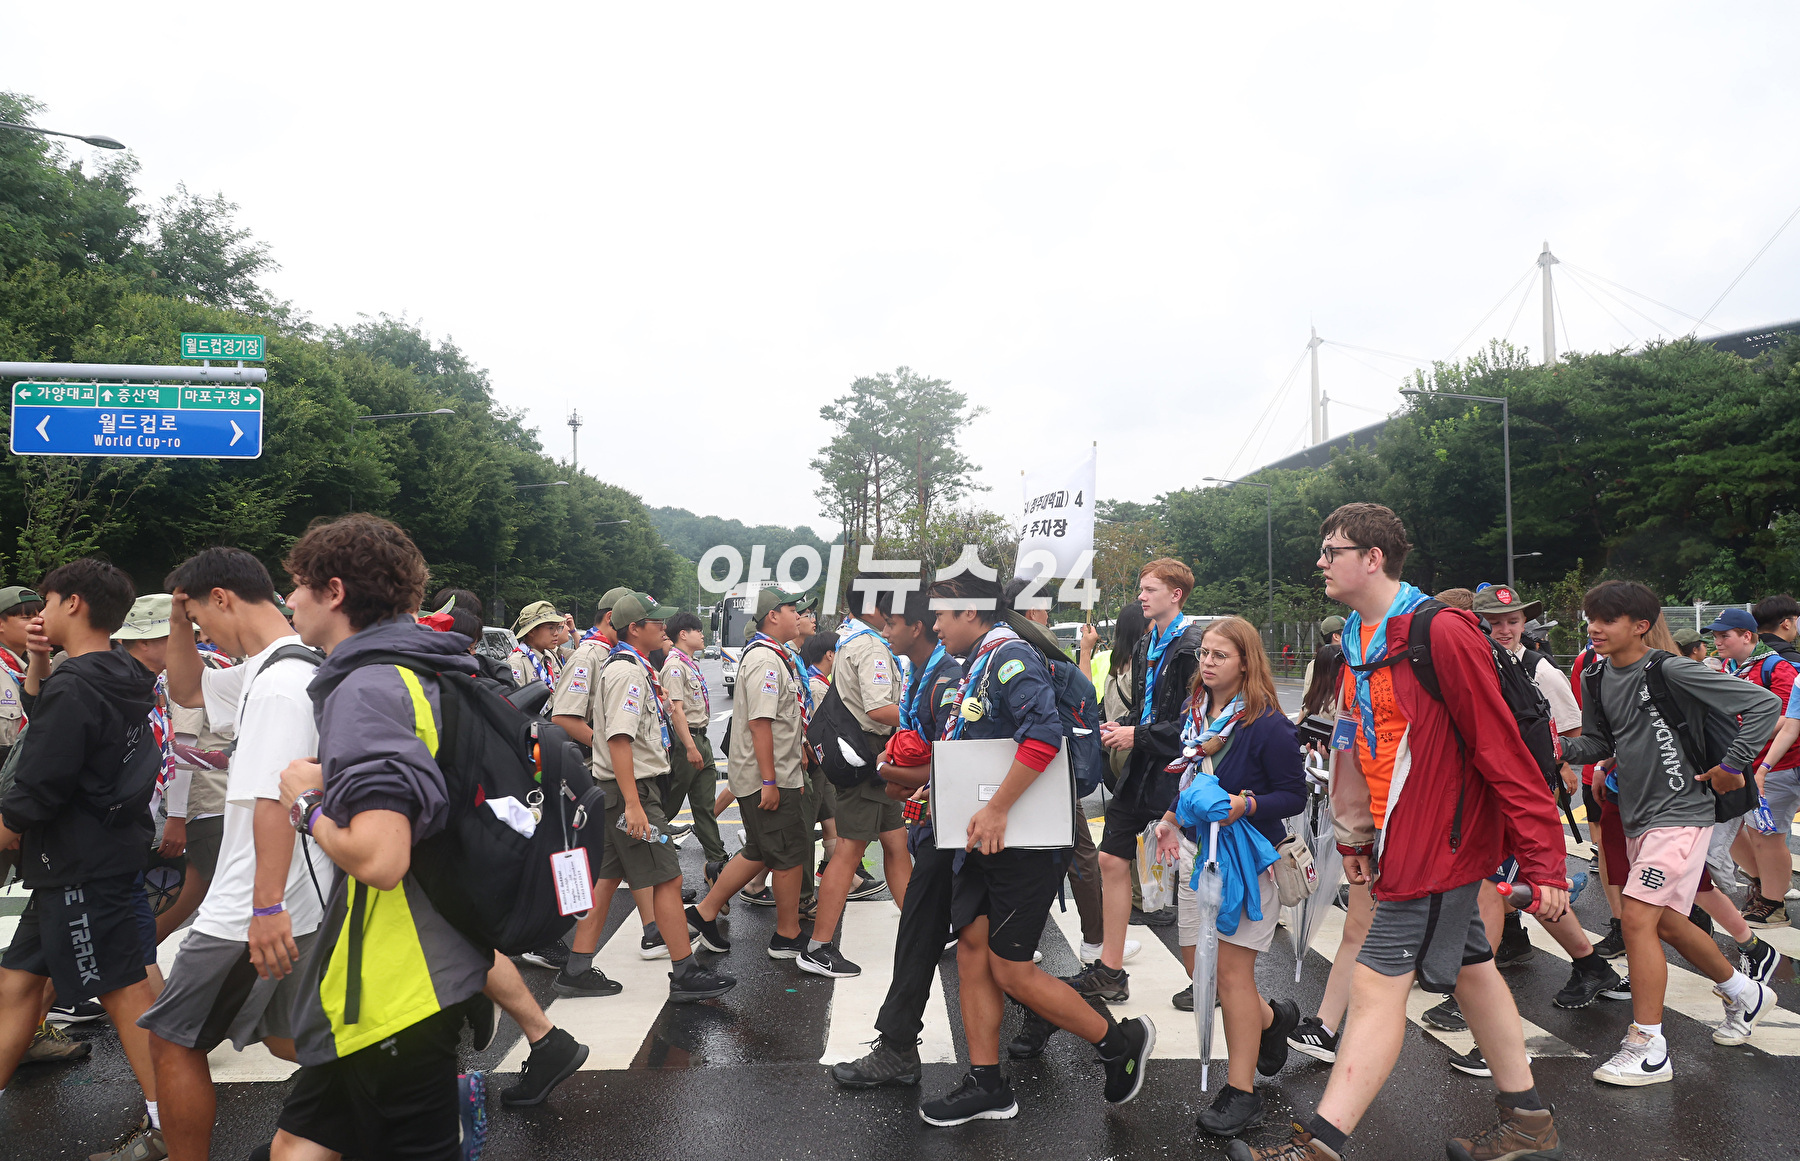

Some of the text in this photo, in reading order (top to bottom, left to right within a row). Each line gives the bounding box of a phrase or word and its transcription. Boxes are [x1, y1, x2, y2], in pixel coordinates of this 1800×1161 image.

[185, 337, 259, 356] 월드컵경기장
[37, 386, 95, 402] 가양대교
[117, 388, 160, 403] 증산역
[184, 390, 241, 406] 마포구청
[98, 413, 178, 434] 월드컵로
[93, 434, 181, 450] World Cup-ro
[1074, 490, 1083, 508] 4
[1030, 519, 1068, 538] 주차장
[1652, 718, 1685, 792] CANADA
[68, 913, 101, 986] TRACK
